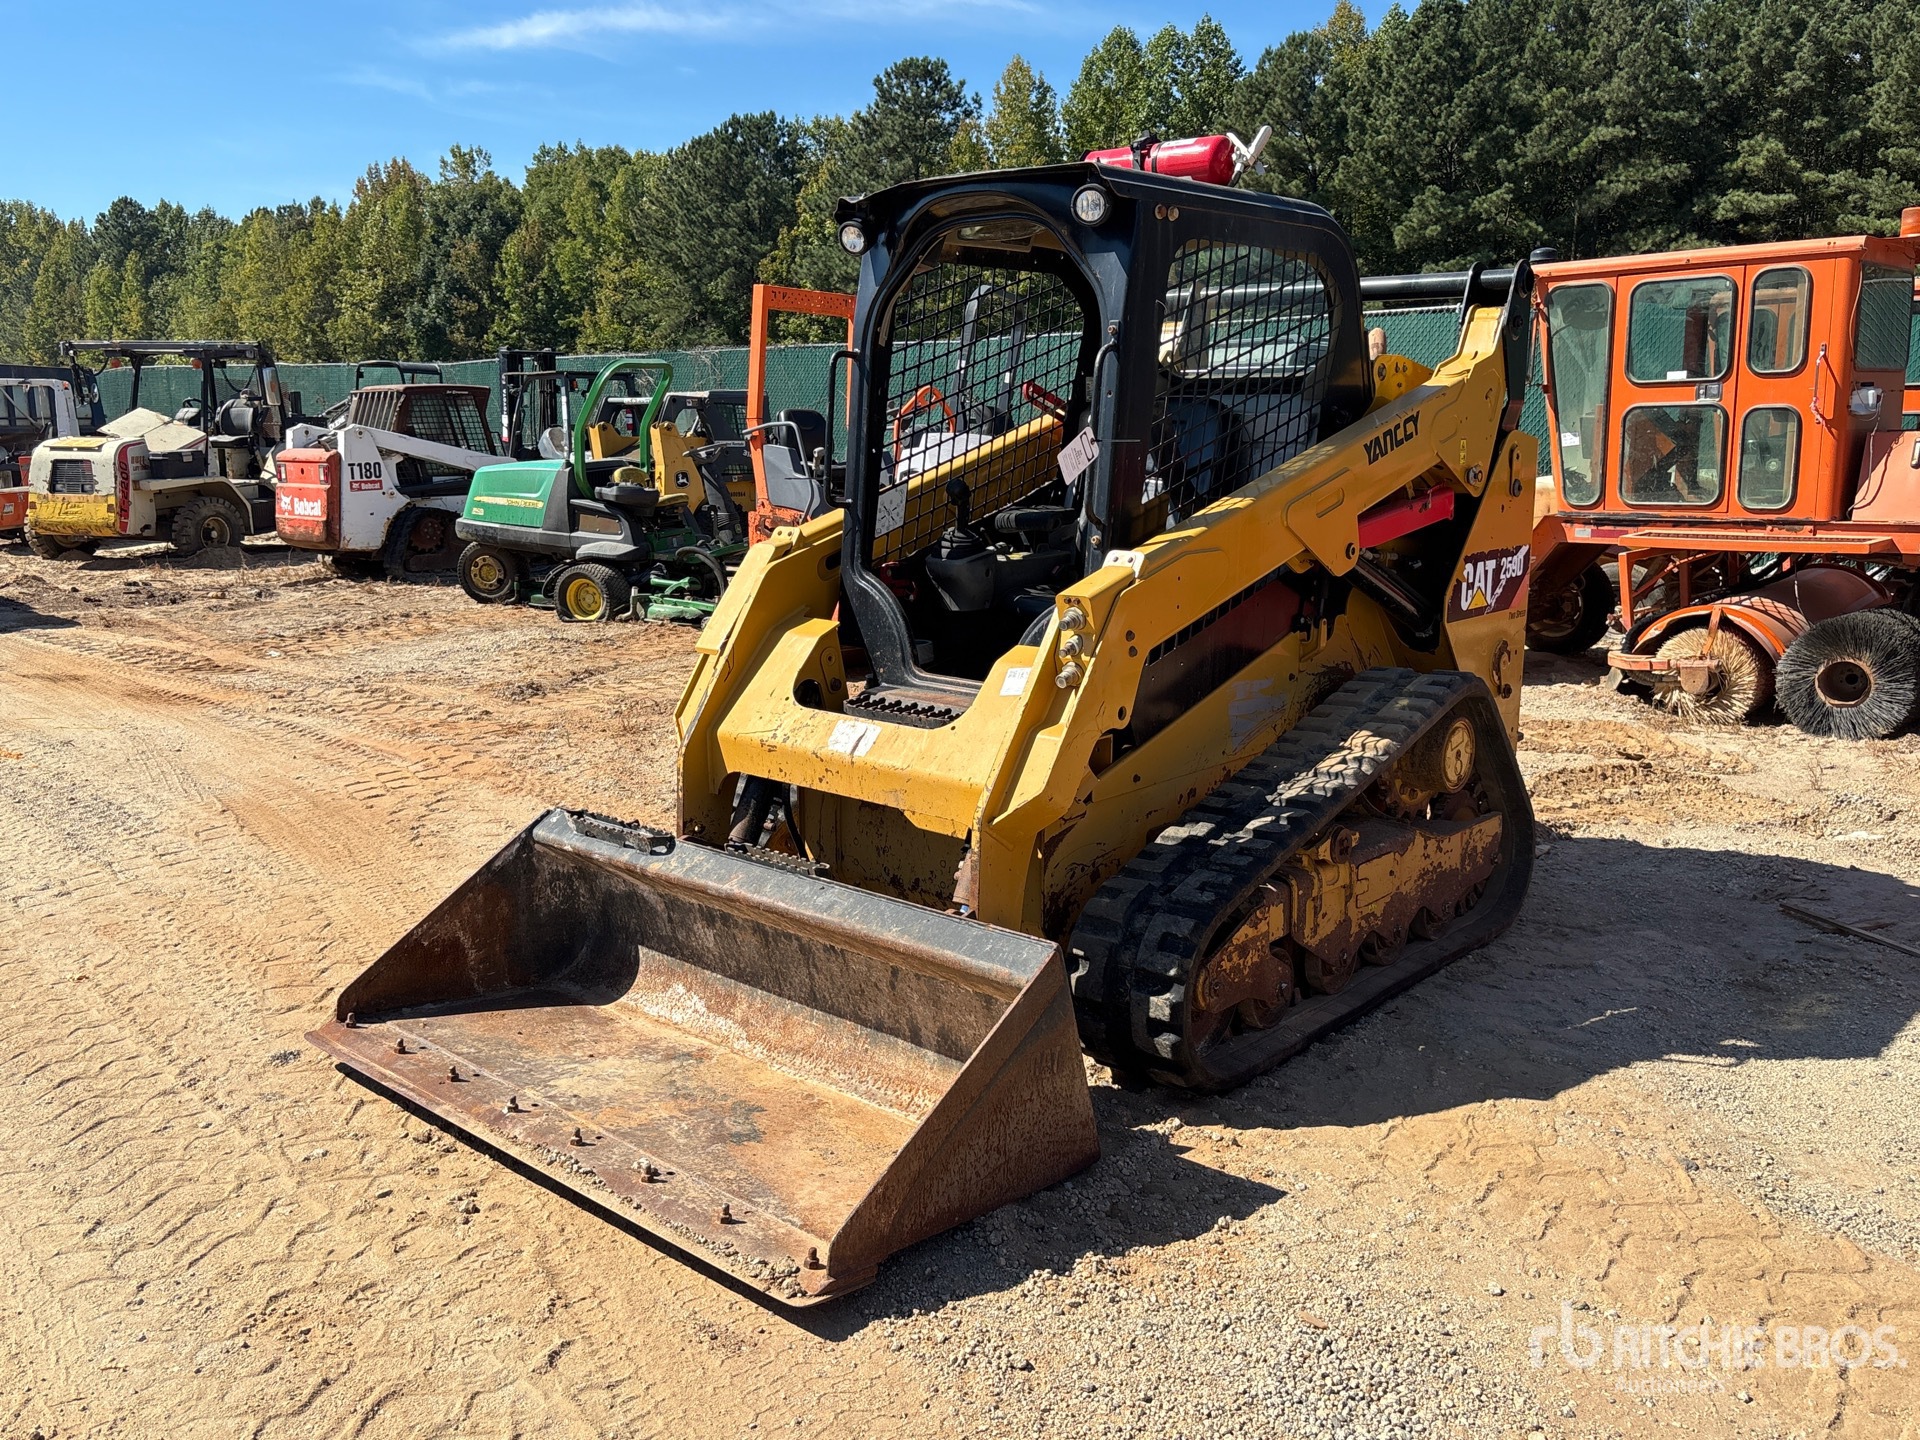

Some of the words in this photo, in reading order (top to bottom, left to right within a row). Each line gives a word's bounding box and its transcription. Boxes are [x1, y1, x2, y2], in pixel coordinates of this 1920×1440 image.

[348, 462, 382, 480] T180
[294, 498, 321, 517] Bobcat
[1461, 559, 1496, 611] CAT
[1500, 553, 1524, 579] 259D
